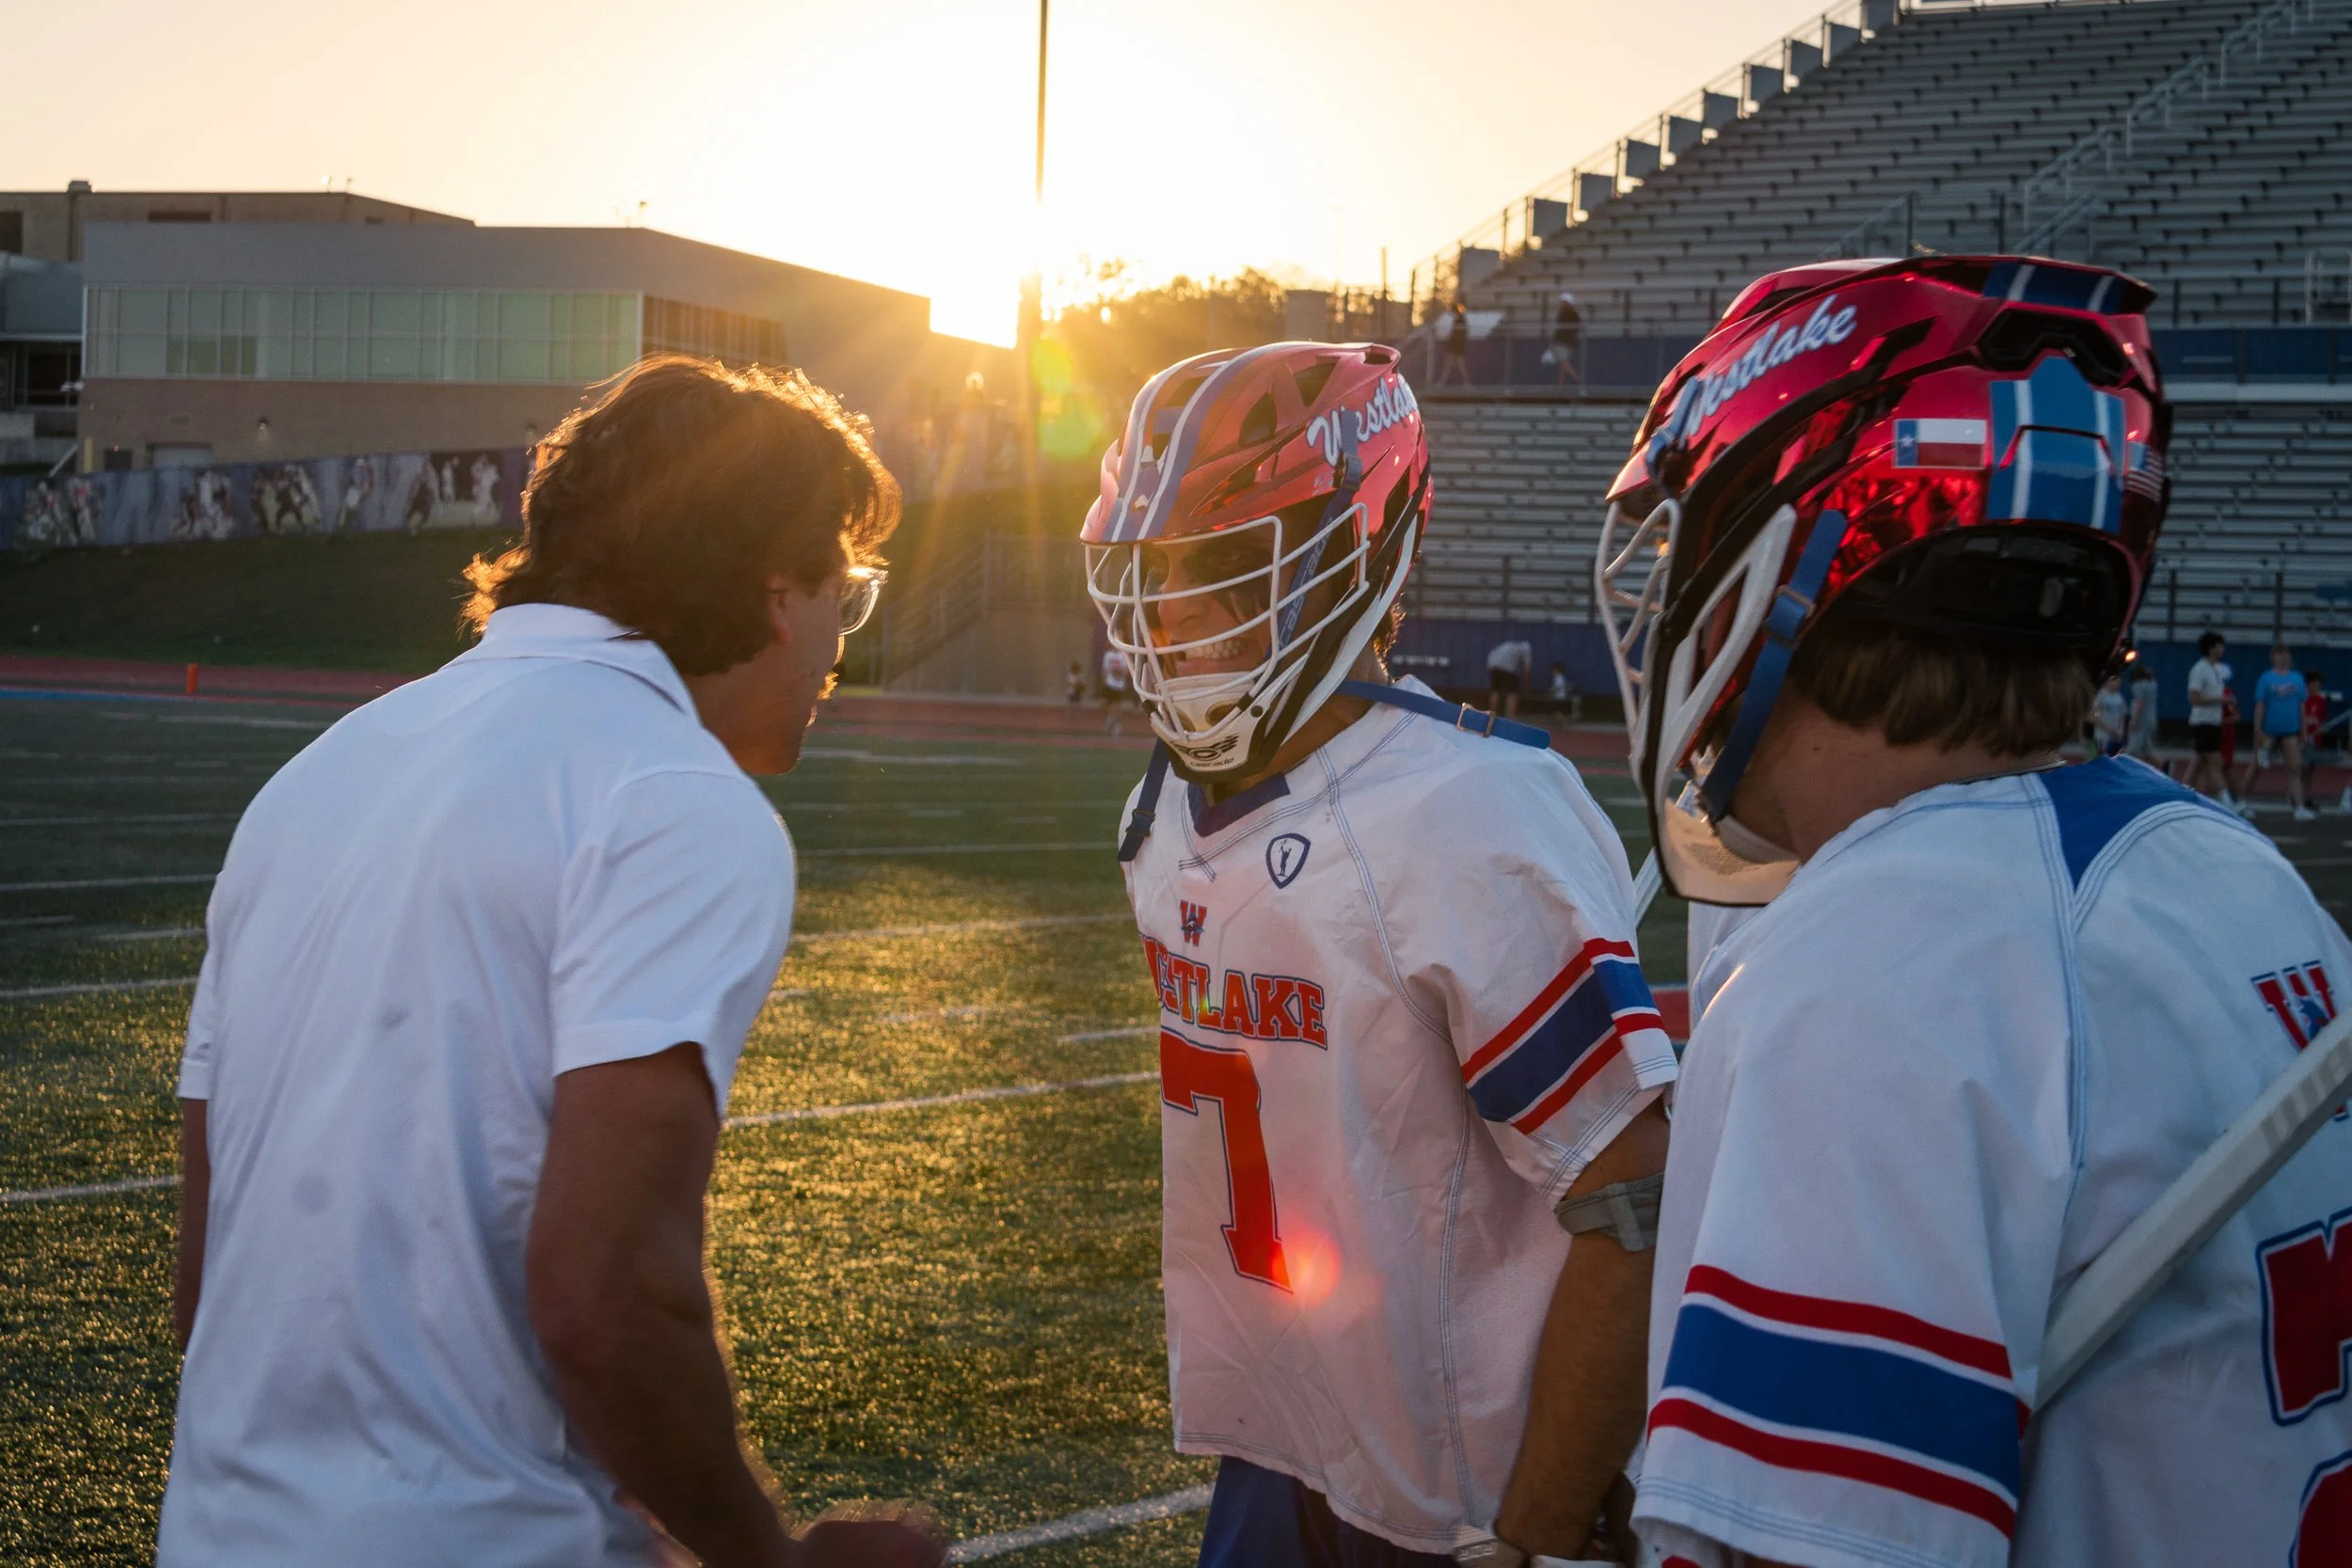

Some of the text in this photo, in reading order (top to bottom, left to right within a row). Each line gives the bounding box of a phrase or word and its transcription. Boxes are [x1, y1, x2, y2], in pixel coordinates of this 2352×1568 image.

[1306, 372, 1418, 467] Westlak
[1180, 899, 1207, 947] W
[1140, 931, 1327, 1051] ESTLAKE
[1161, 1025, 1294, 1294] 7
